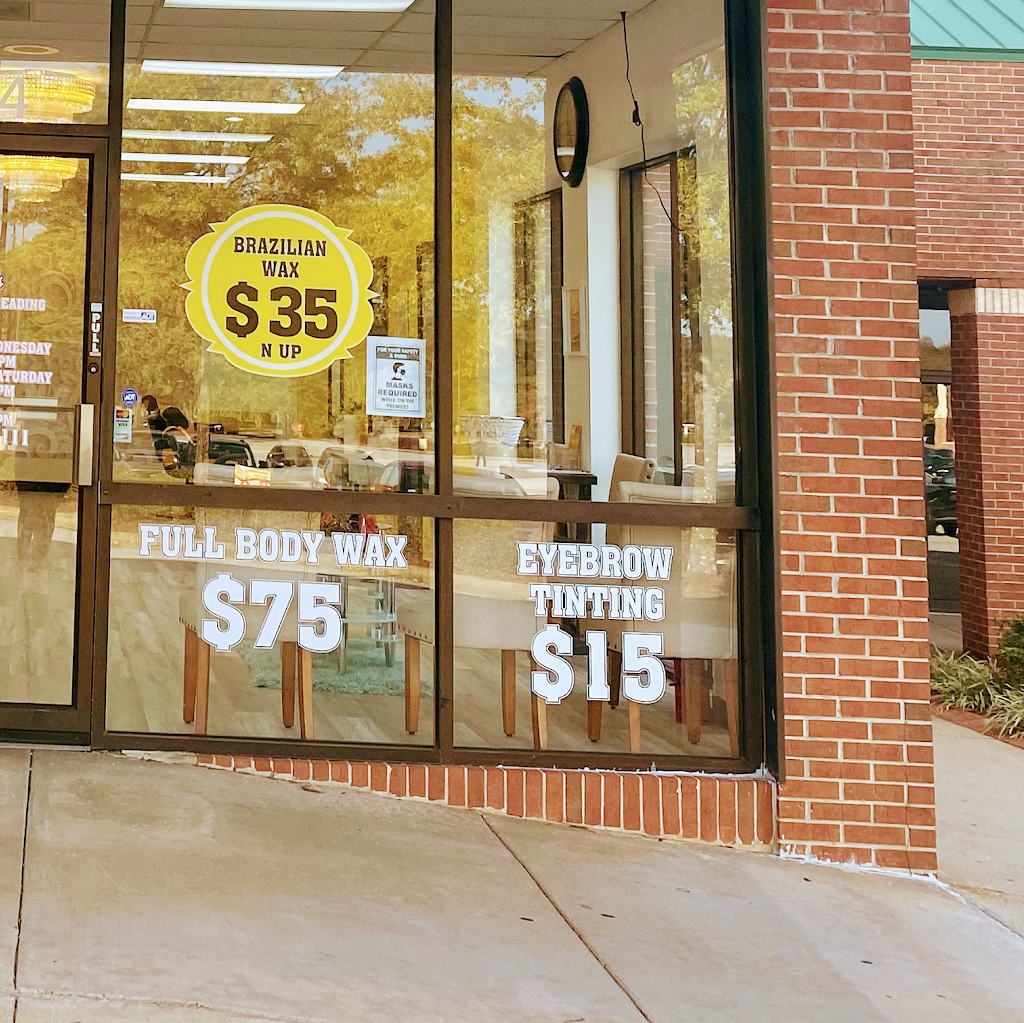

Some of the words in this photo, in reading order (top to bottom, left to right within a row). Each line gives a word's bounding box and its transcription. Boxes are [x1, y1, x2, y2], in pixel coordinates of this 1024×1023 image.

[233, 236, 327, 257] BRAZILIAN
[262, 260, 300, 278] WAX
[91, 312, 102, 353] PULL
[261, 344, 272, 358] N
[279, 344, 302, 359] UP
[378, 389, 417, 397] REQUIRED
[386, 381, 414, 389] MASKS
[137, 523, 225, 560] FULL
[235, 528, 327, 565] BODY
[331, 532, 409, 569] WAX
[517, 541, 674, 581] EYEBROW
[200, 572, 343, 654] $75
[529, 583, 667, 621] TINTING
[531, 623, 667, 705] $15
